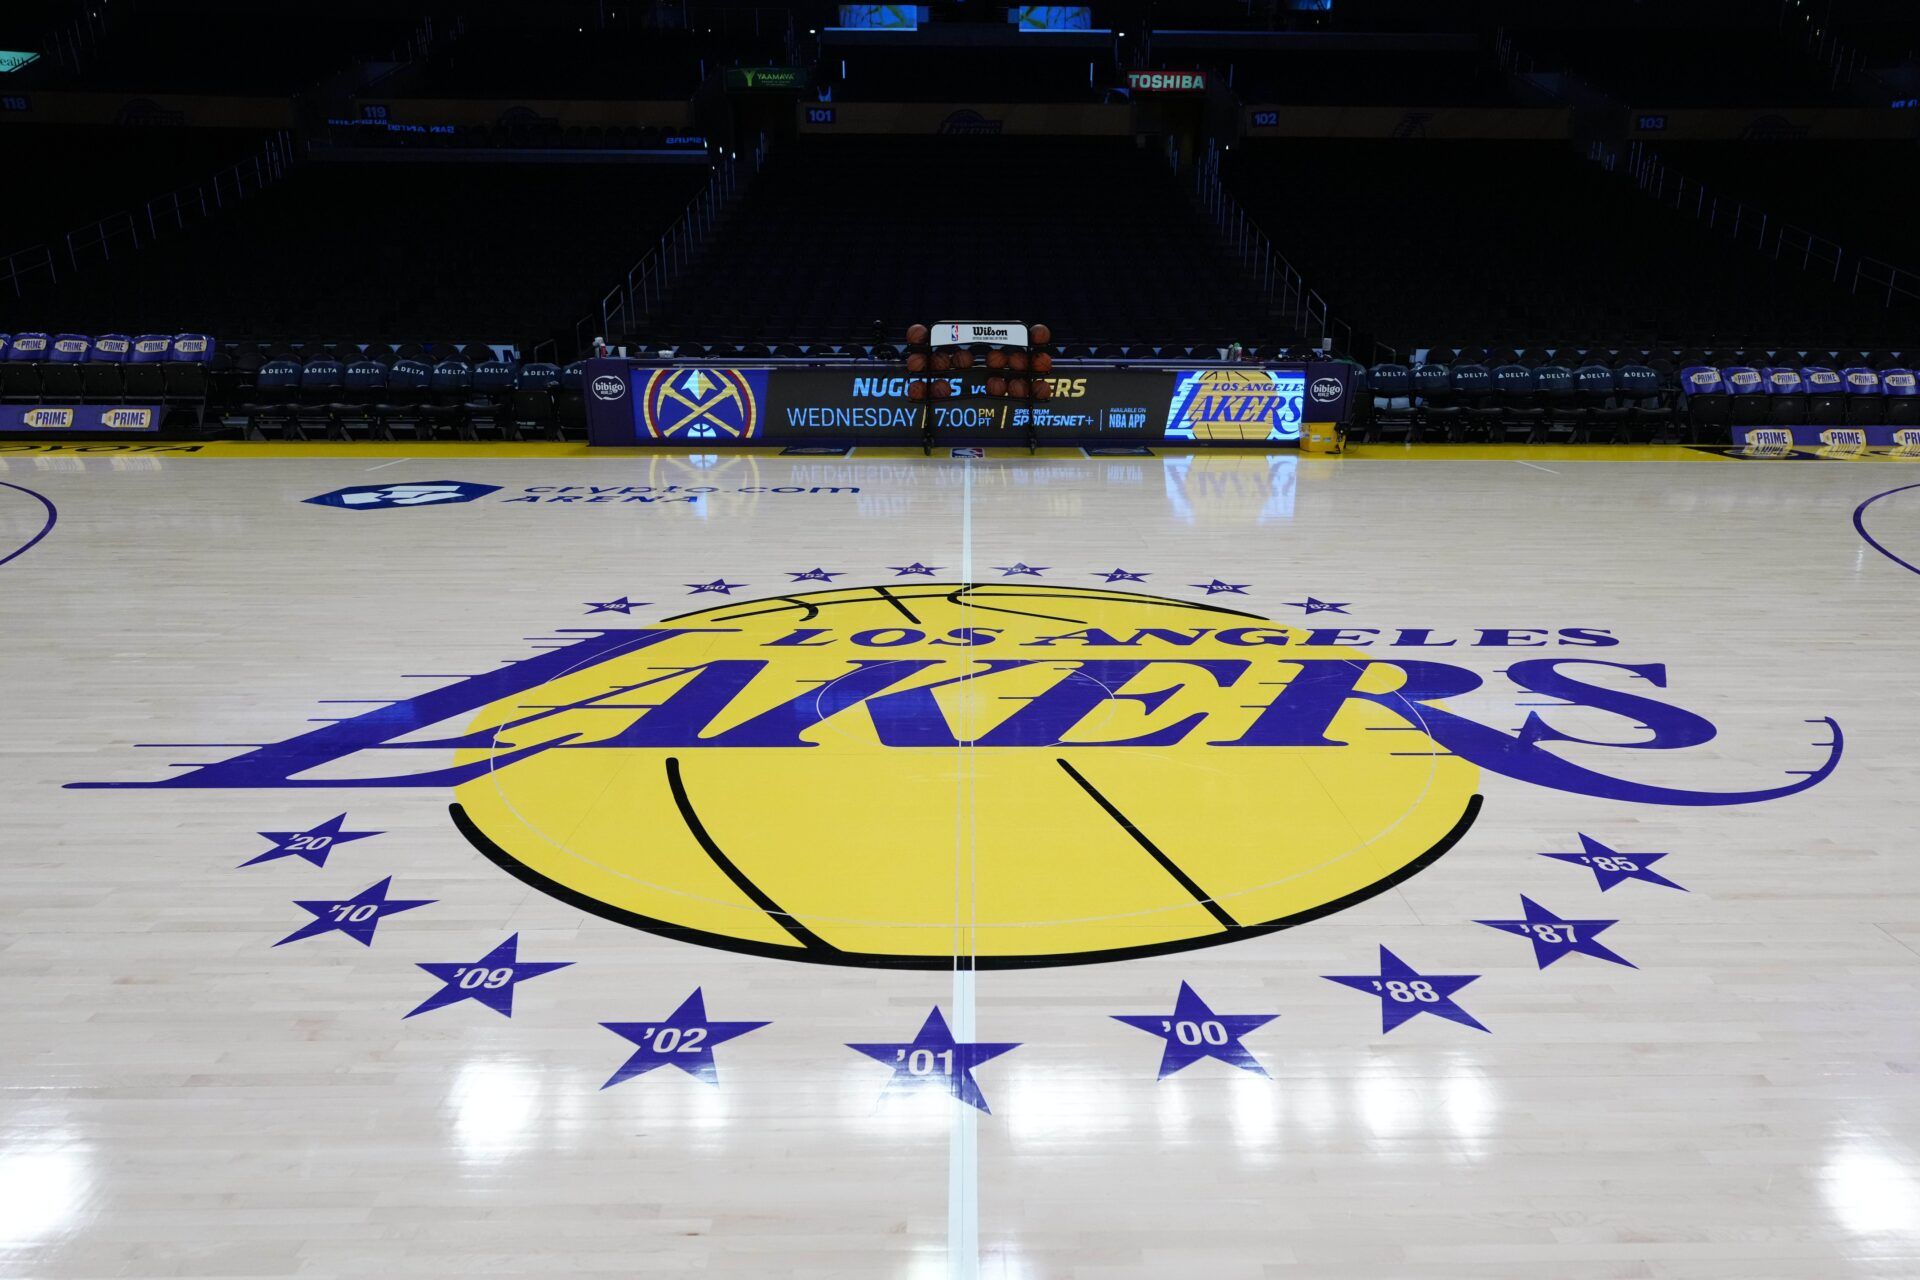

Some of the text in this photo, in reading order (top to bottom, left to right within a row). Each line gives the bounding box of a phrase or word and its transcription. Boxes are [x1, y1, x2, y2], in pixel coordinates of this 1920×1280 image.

[1128, 74, 1205, 90] TOSHIBA
[1, 97, 27, 110] 118
[363, 105, 387, 118] 119
[808, 109, 832, 122] 101
[1254, 112, 1279, 125] 102
[1639, 116, 1665, 129] 103
[972, 326, 1008, 336] Wilson
[21, 340, 42, 349] PRIME
[62, 341, 83, 351] PRIME
[103, 341, 124, 351] PRIME
[144, 342, 164, 351] PRIME
[182, 341, 203, 350] PRIME
[268, 367, 294, 375] DELTA
[311, 367, 337, 375] DELTA
[355, 367, 381, 375] DELTA
[400, 366, 425, 376] DELTA
[442, 368, 467, 376] DELTA
[483, 366, 510, 375] DELTA
[530, 369, 556, 377] DELTA
[1382, 370, 1407, 378] DELTA
[1422, 370, 1448, 378] DELTA
[1463, 371, 1489, 379] DELTA
[1505, 370, 1531, 379] DELTA
[1546, 371, 1572, 380] DELTA
[1586, 371, 1612, 380] DELTA
[1631, 370, 1657, 379] DELTA
[1697, 373, 1717, 382] PRIME
[1737, 373, 1758, 383] PRIME
[1777, 374, 1798, 383] PRIME
[1817, 373, 1837, 382] PRIME
[1854, 374, 1875, 383] PRIME
[1891, 375, 1912, 385] PRIME
[595, 381, 623, 394] bibigo
[852, 377, 963, 397] NUGS
[1211, 382, 1239, 391] LOS
[1313, 384, 1341, 396] bibigo
[1166, 382, 1304, 434] LAKERS
[36, 412, 68, 425] PRIME
[113, 412, 145, 425] PRIME
[786, 408, 995, 427] WEDNESDAY 7:00 PM
[979, 418, 991, 427] PT
[1109, 414, 1146, 428] NBA APP
[1756, 431, 1788, 444] PRIME
[1830, 431, 1861, 444] PRIME
[524, 485, 861, 495] crypto.com
[500, 495, 699, 503] ARENA
[759, 627, 1620, 647] LOS ANGELES
[62, 628, 1844, 806] LAKERS
[284, 833, 333, 850] '20
[1580, 856, 1640, 873] '85
[329, 905, 379, 922] '10
[1519, 924, 1578, 944] '87
[453, 968, 514, 989] '09
[1372, 980, 1440, 1003] '88
[1161, 1020, 1229, 1046] '00
[643, 1028, 708, 1053] '02
[896, 1049, 953, 1075] '01
